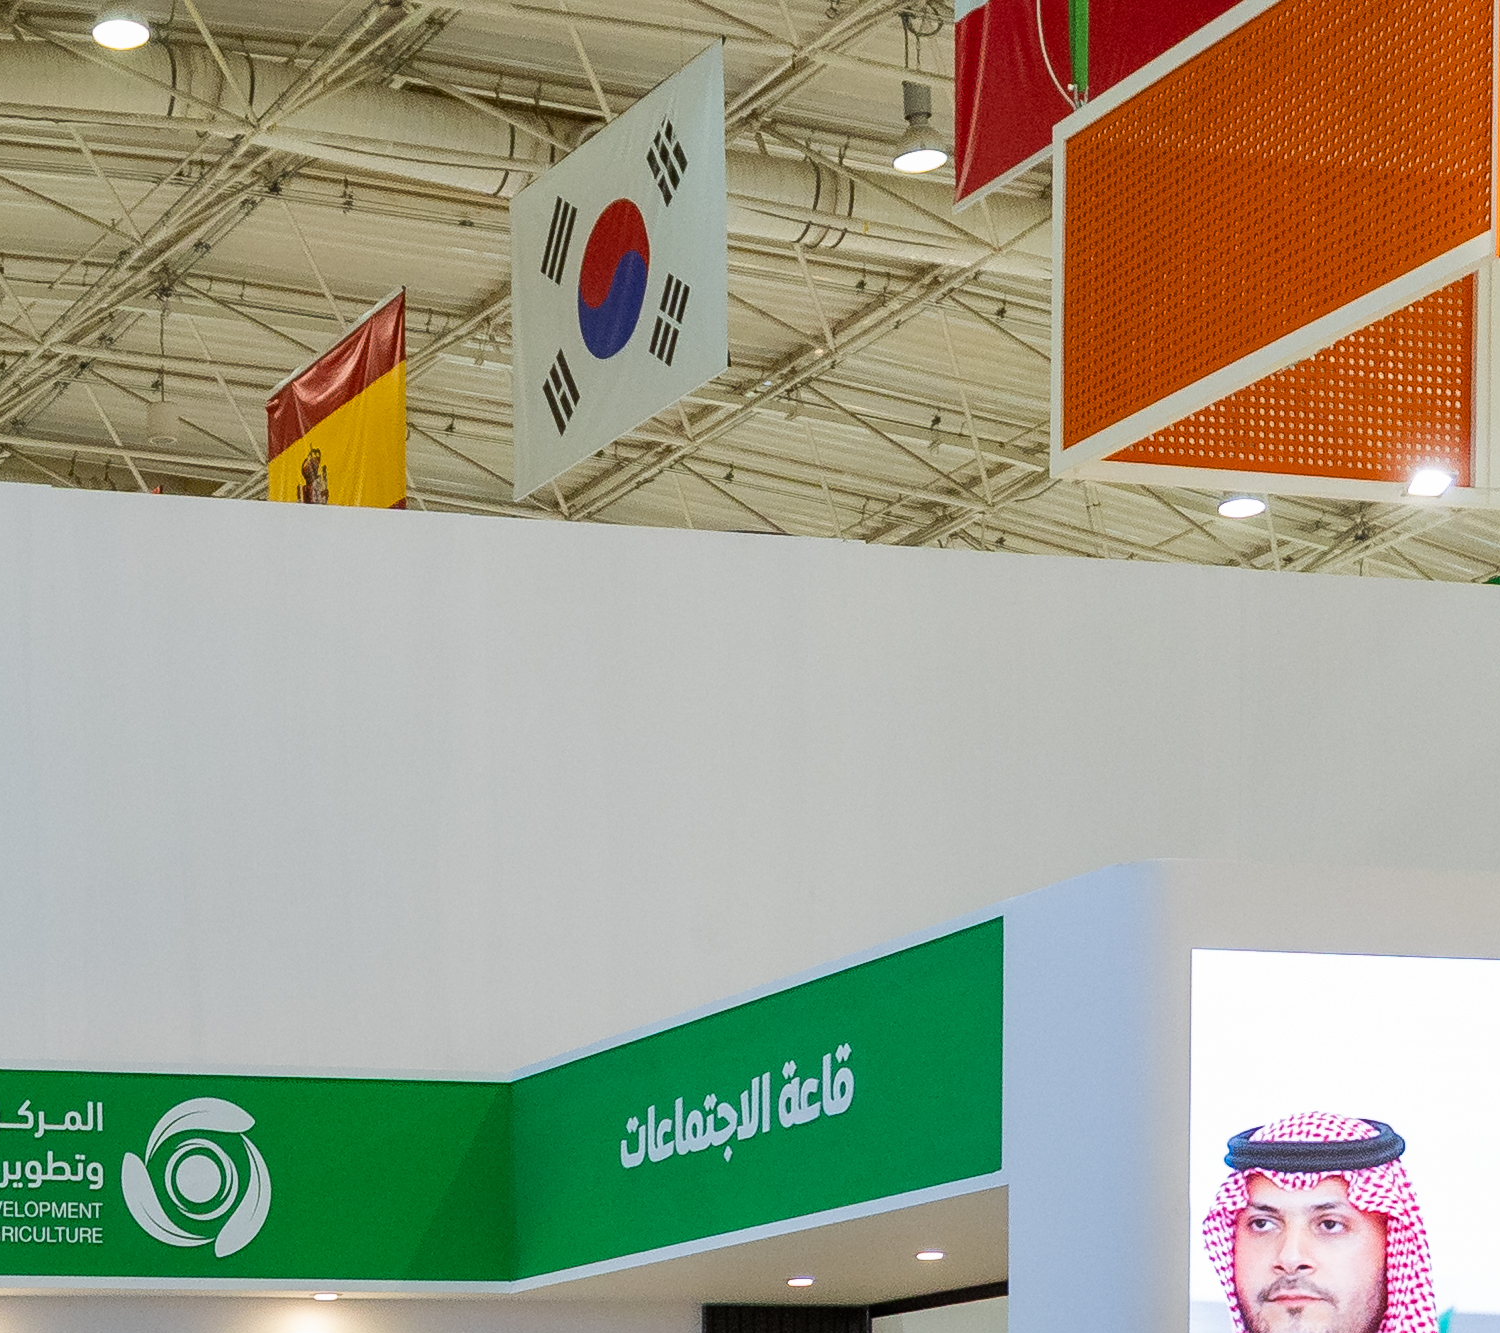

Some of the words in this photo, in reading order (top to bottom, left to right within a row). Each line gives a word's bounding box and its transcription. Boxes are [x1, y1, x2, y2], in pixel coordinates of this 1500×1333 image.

[620, 1072, 770, 1168] الاجتماعات
[778, 1043, 854, 1128] قاعة
[0, 1150, 104, 1189] وتطوير
